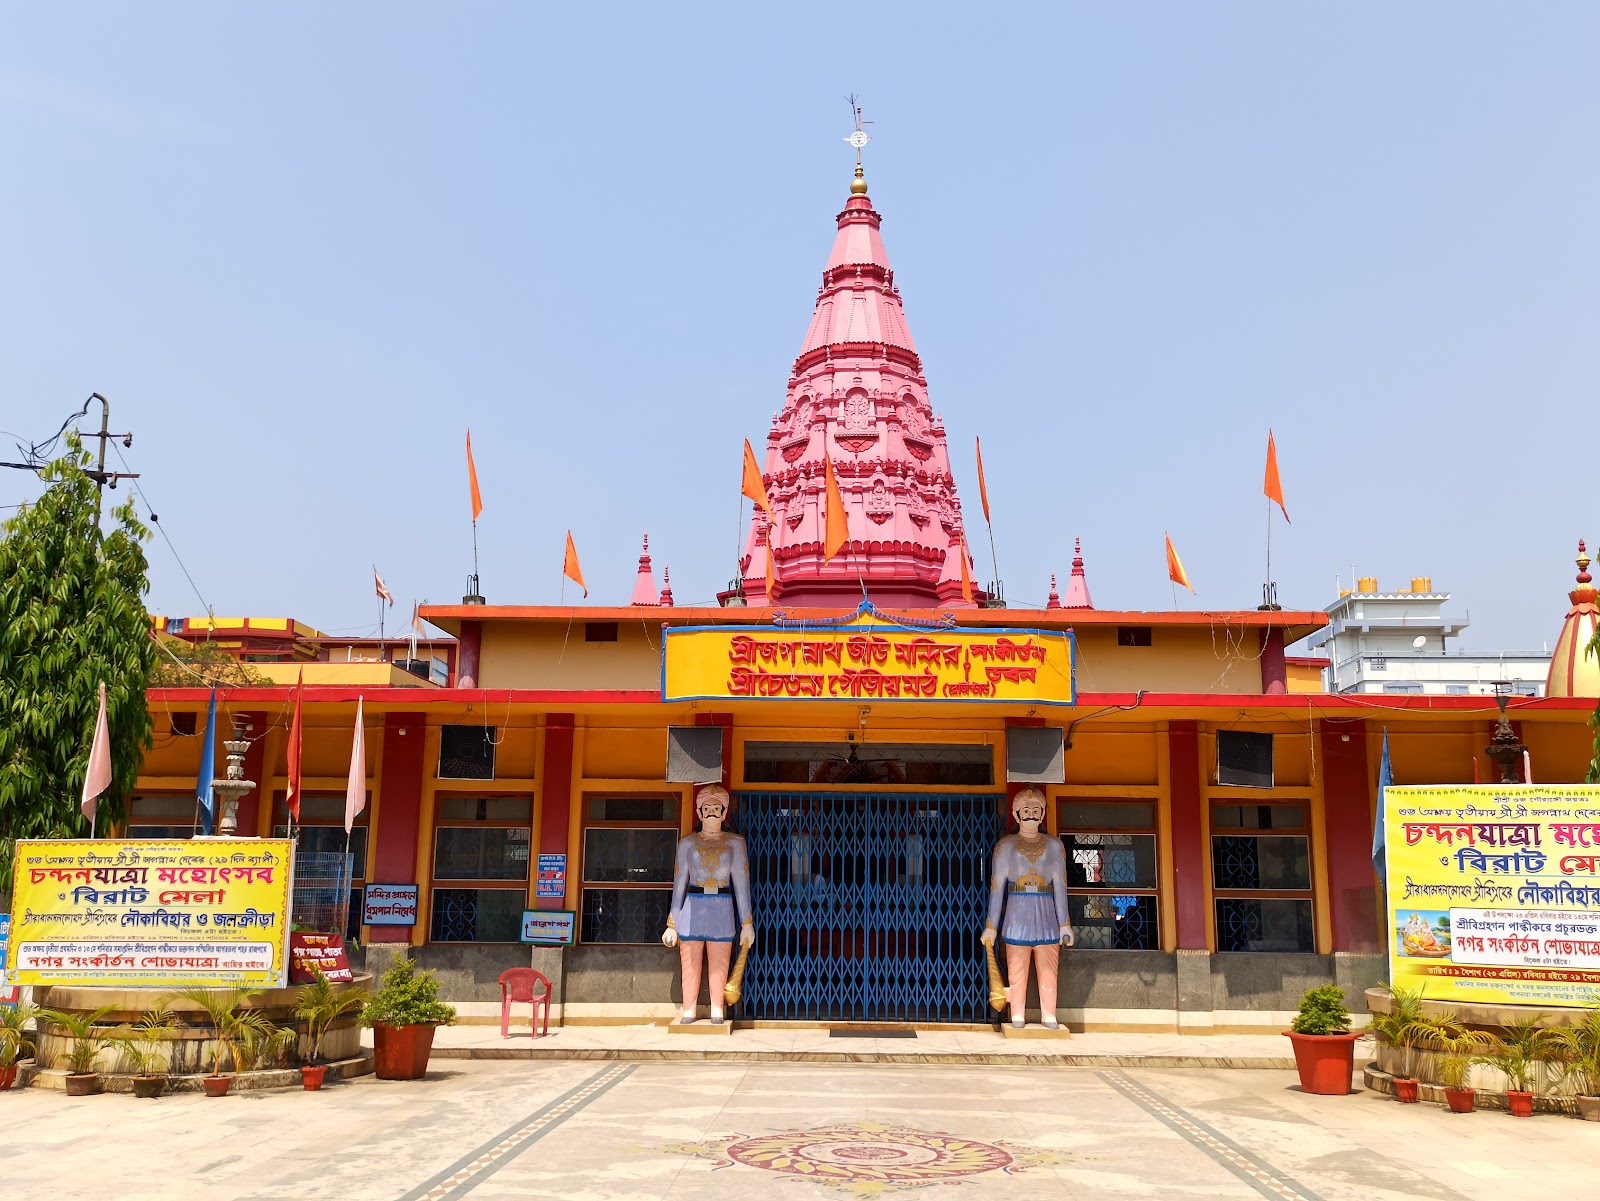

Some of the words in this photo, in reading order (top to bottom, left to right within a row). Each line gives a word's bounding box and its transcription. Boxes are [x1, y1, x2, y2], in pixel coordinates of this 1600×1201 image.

[894, 636, 962, 666] মন্দির
[727, 664, 825, 697] শ্রীচৈতন্য
[901, 667, 938, 697] মঠ
[985, 667, 1037, 684] ভবন
[1495, 804, 1512, 820] শ্রী
[1511, 804, 1528, 820] শ্রী
[1401, 822, 1543, 848] চন্দনযাত্রা
[112, 852, 127, 866] শ্রী
[125, 852, 140, 866] শ্রী
[230, 852, 246, 864] দিন
[1439, 856, 1449, 866] ও
[1453, 847, 1548, 873] বিরাট
[29, 867, 150, 884] চন্দনযাত্রা
[155, 867, 275, 884] মহোৎসব
[58, 893, 67, 901] ও
[70, 886, 151, 905] বিরাট
[158, 889, 227, 905] মেলা
[367, 887, 391, 900] মন্দির
[391, 902, 416, 918] নিষেধ
[121, 908, 192, 929] নৌকাবিহার
[196, 913, 208, 926] ও
[212, 908, 276, 931] জলক্রীড়া
[1456, 935, 1484, 952] নগর
[1486, 933, 1541, 954] সংকীর্তন
[27, 956, 64, 968] নগর
[68, 953, 137, 968] সংকীর্তন
[141, 956, 219, 968] শোভাযাত্রা
[1523, 970, 1547, 980] রবিবার
[1548, 971, 1569, 981] হইতে
